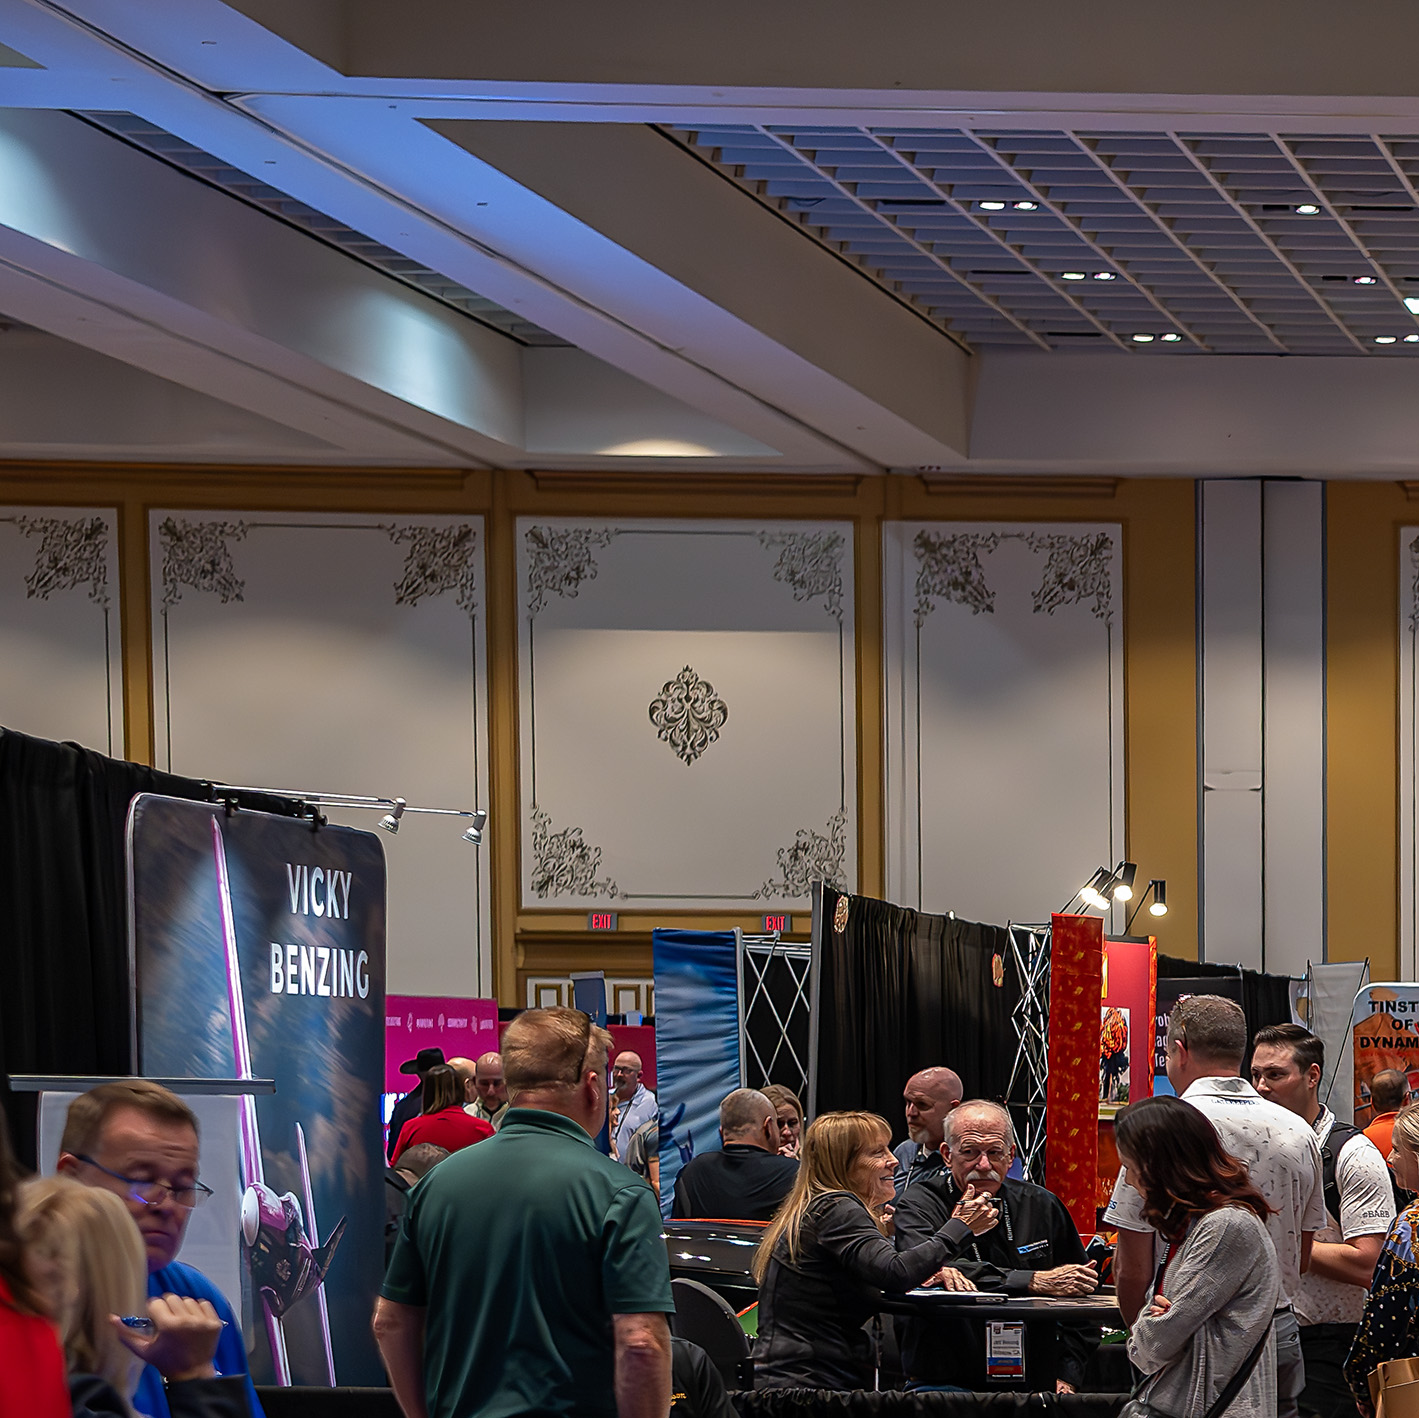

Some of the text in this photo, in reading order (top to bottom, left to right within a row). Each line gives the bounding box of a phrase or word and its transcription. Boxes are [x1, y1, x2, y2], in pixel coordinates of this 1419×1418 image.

[286, 863, 352, 920] VICKY
[592, 914, 612, 929] EXIT
[765, 915, 785, 931] EXIT
[270, 942, 370, 999] BENZING
[1391, 1018, 1413, 1031] OF
